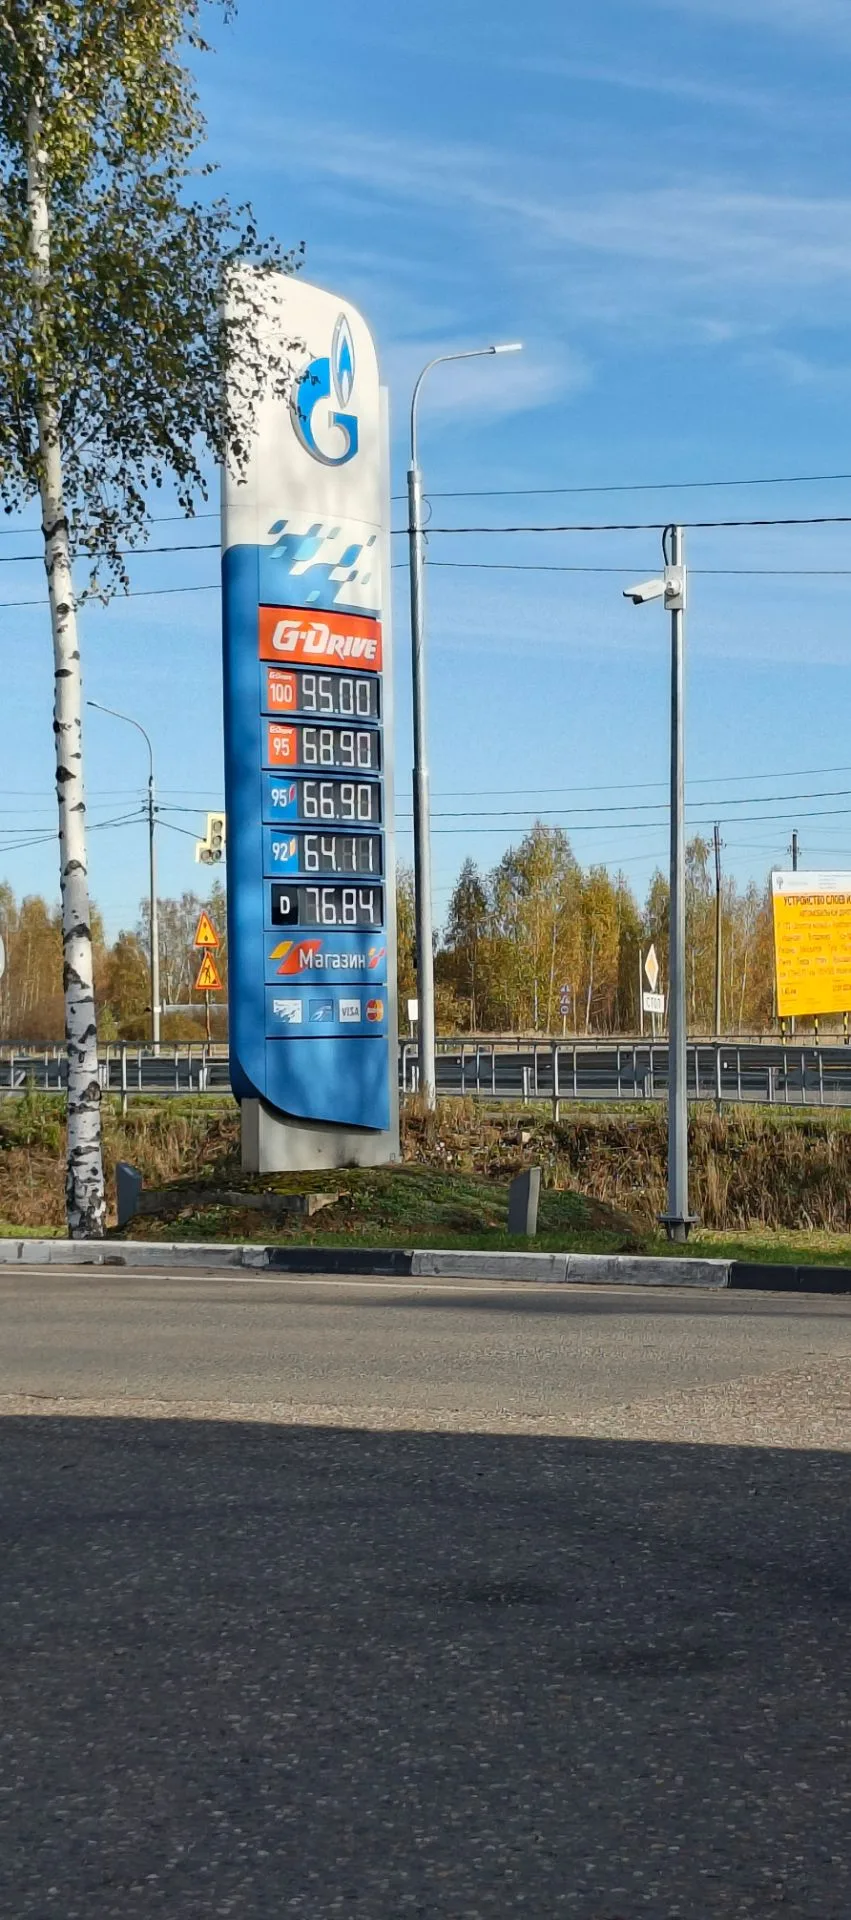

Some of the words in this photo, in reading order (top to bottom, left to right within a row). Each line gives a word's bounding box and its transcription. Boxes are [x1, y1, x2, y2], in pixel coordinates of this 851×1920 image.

[270, 683, 293, 704] 100
[302, 674, 371, 716] 95.00
[273, 737, 290, 757] 95
[302, 727, 371, 768] 68.90
[271, 788, 287, 808] 95
[303, 781, 372, 821] 66.90
[272, 842, 289, 862] 92
[304, 834, 373, 872] 64.11
[279, 895, 291, 915] D
[306, 887, 374, 925] 76.84
[298, 947, 366, 969] Магазин
[342, 1005, 360, 1017] VISA
